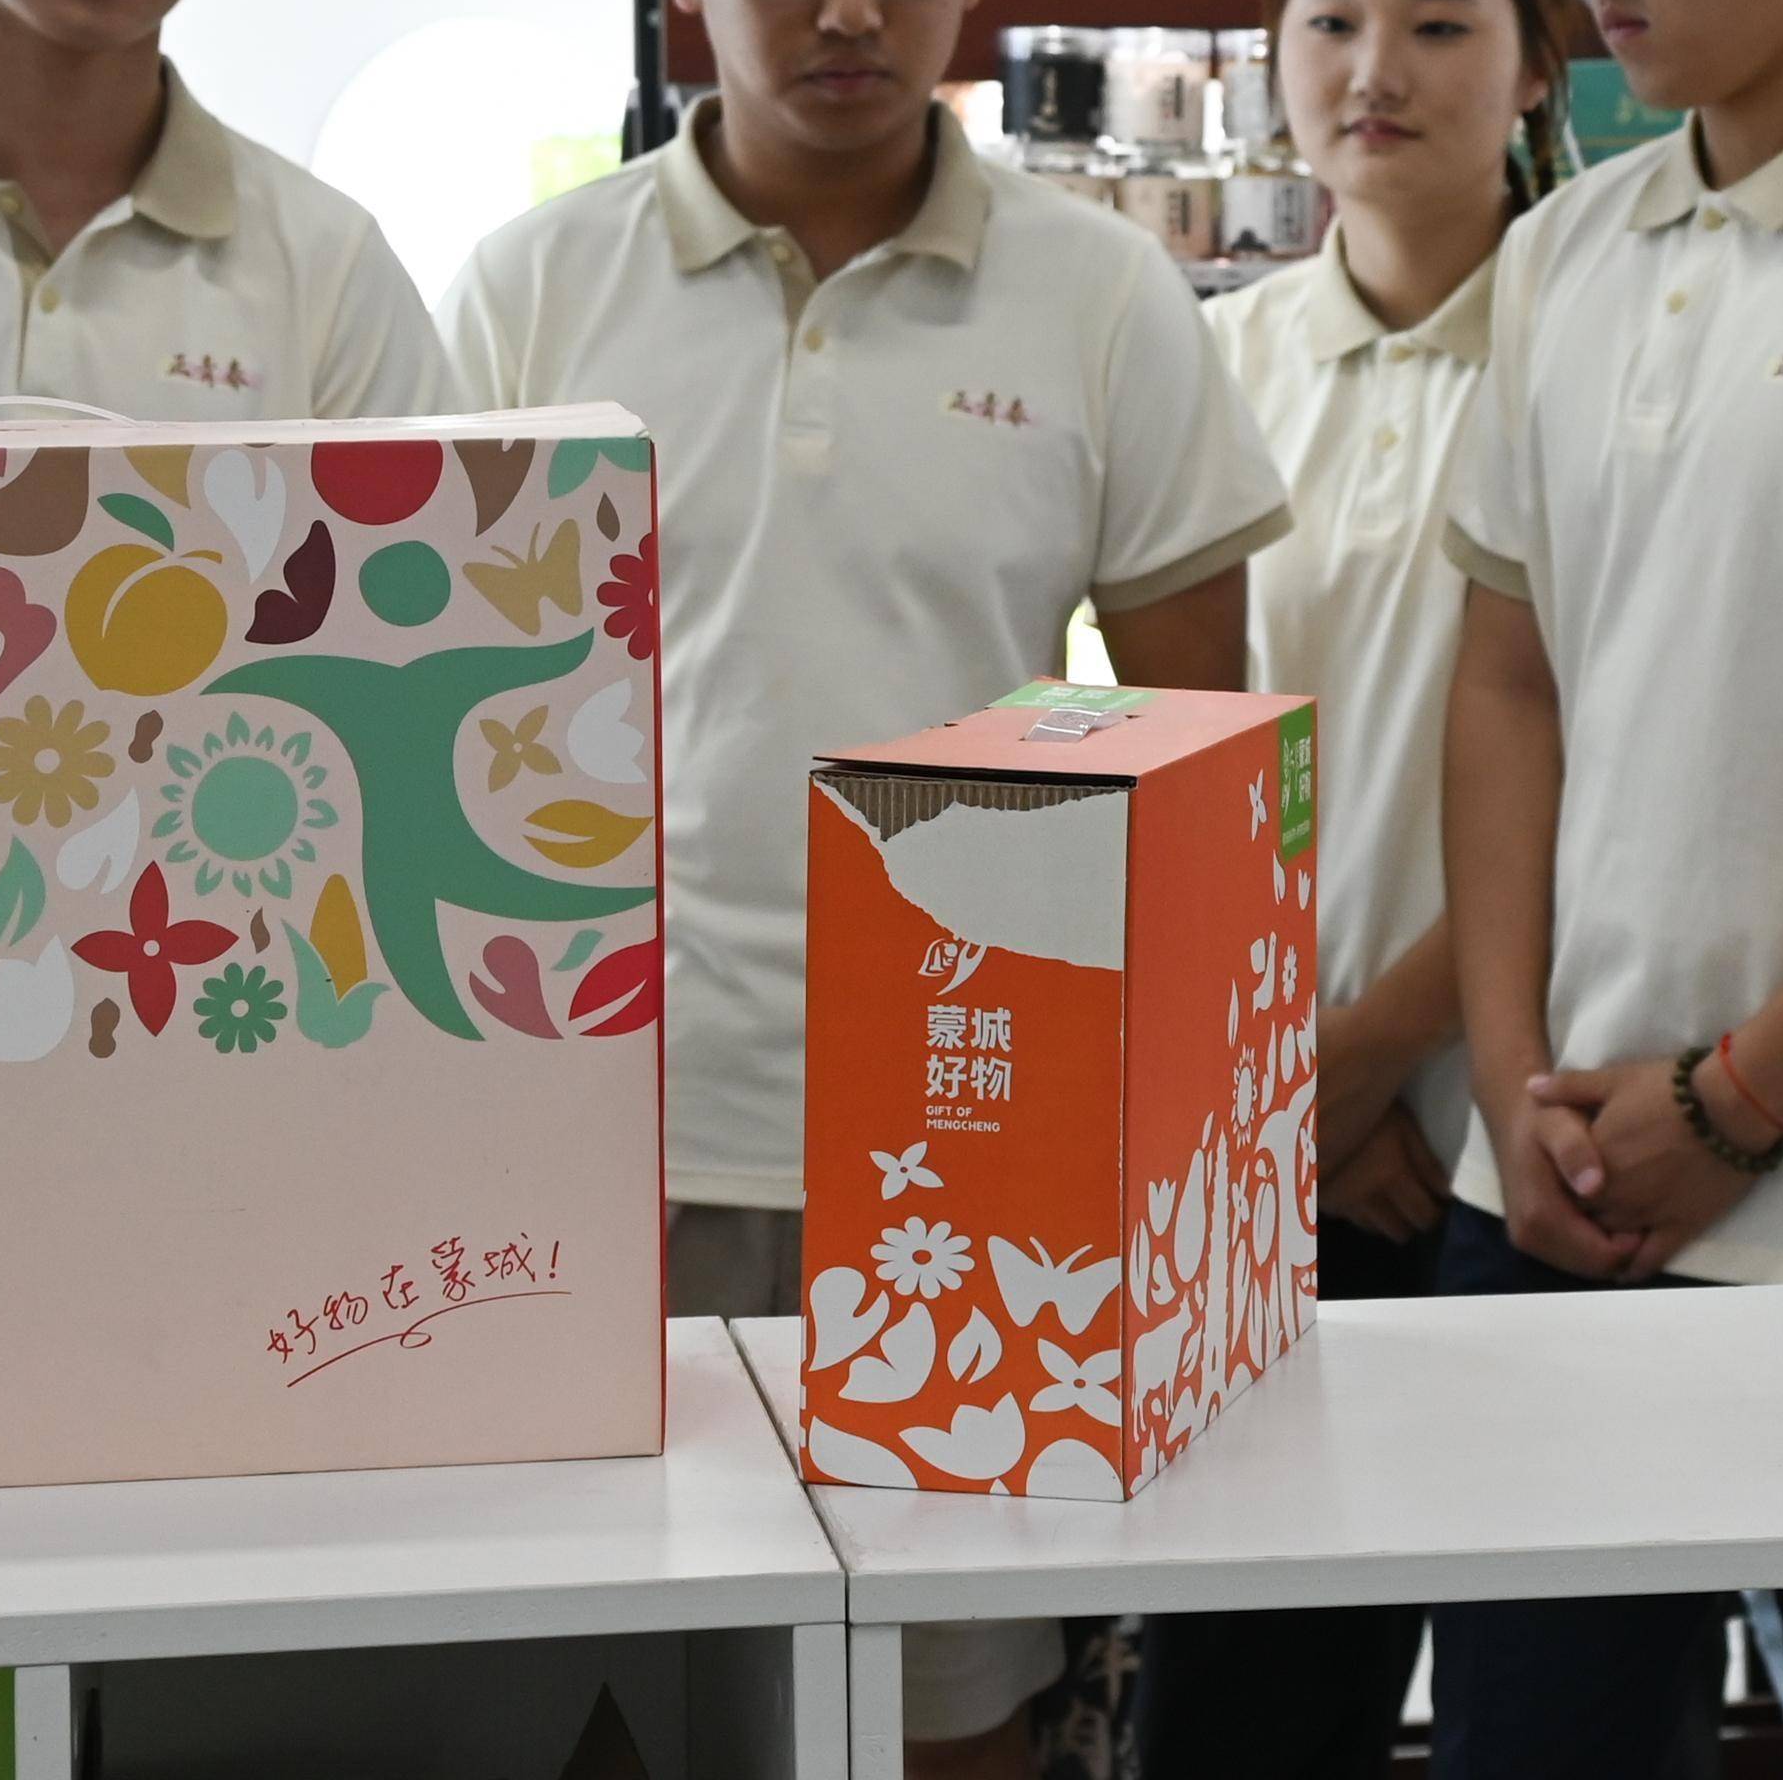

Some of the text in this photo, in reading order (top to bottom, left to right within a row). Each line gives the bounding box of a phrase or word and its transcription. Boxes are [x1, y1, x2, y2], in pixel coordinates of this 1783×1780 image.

[168, 353, 249, 392] 正青春
[948, 390, 1031, 426] 正青春
[925, 1003, 1013, 1053] 蒙城
[924, 1053, 1013, 1102] 好物
[925, 1105, 973, 1118] GIFT OF
[925, 1119, 1001, 1133] MENGCHENG
